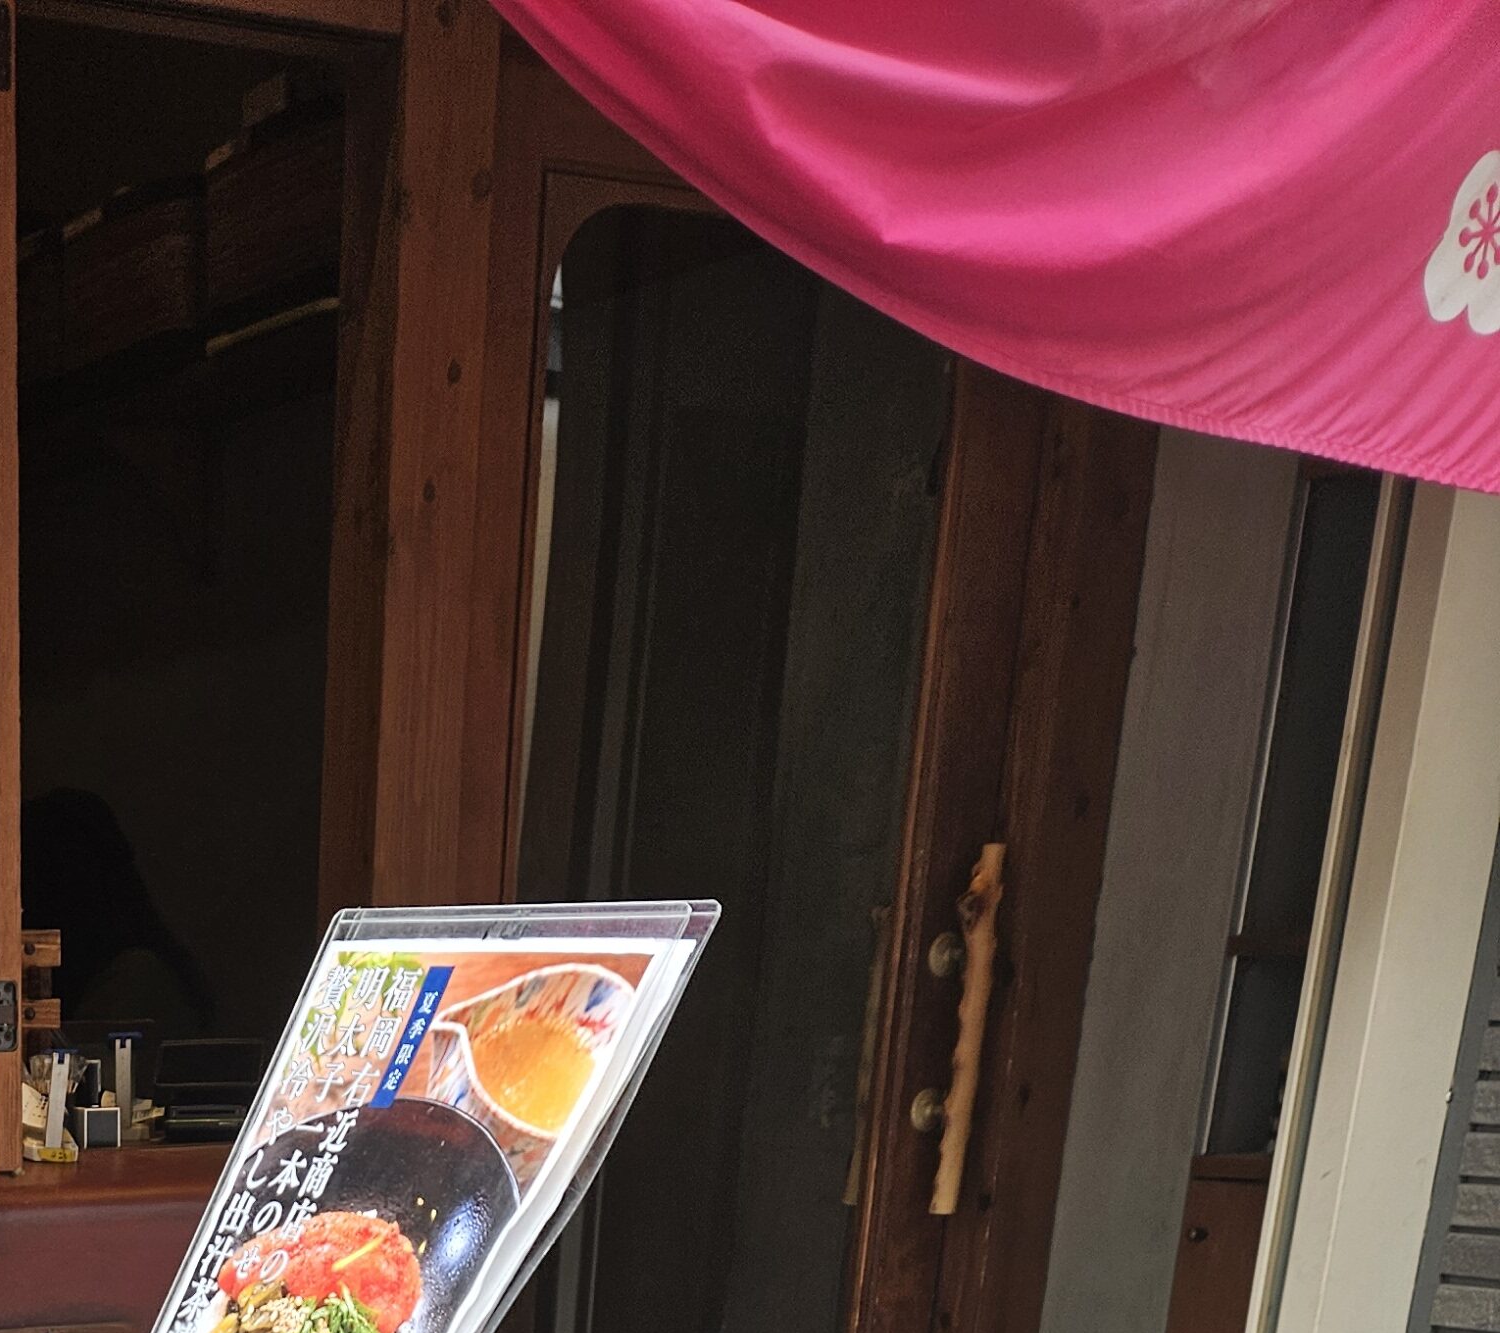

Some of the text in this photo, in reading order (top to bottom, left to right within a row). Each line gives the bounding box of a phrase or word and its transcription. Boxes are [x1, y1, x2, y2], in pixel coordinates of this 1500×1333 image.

[233, 967, 390, 1279] 明太子一本のせ
[260, 967, 423, 1283] 福岡右近商店の
[382, 991, 439, 1091] 夏季限定
